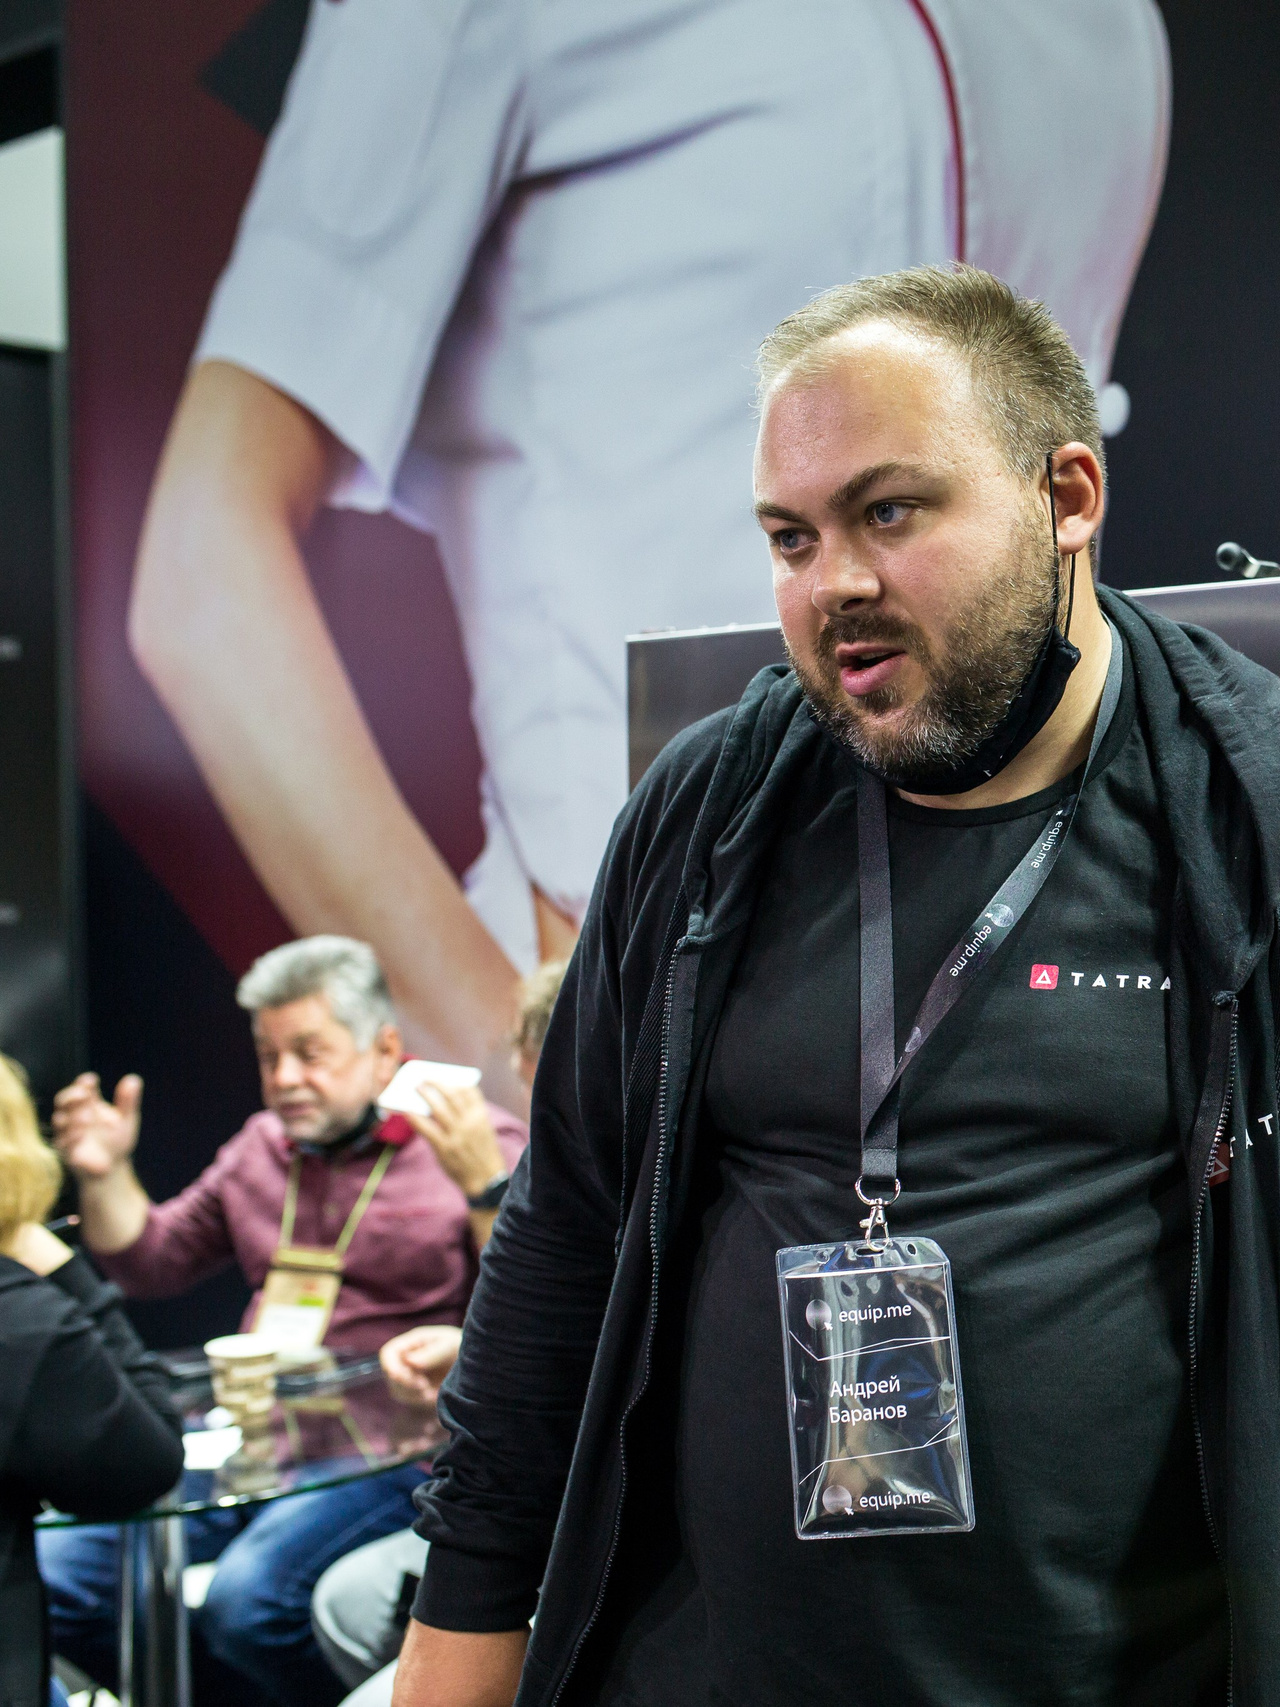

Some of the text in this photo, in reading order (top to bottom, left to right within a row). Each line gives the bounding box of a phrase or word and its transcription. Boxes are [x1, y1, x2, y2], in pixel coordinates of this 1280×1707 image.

[1030, 820, 1063, 868] equip.me
[948, 924, 992, 977] equip.me
[1070, 971, 1171, 990] TATRA
[838, 1304, 912, 1324] equip.me
[830, 1374, 901, 1399] Андрей
[829, 1404, 908, 1425] Баранов
[858, 1491, 931, 1510] equip.me
